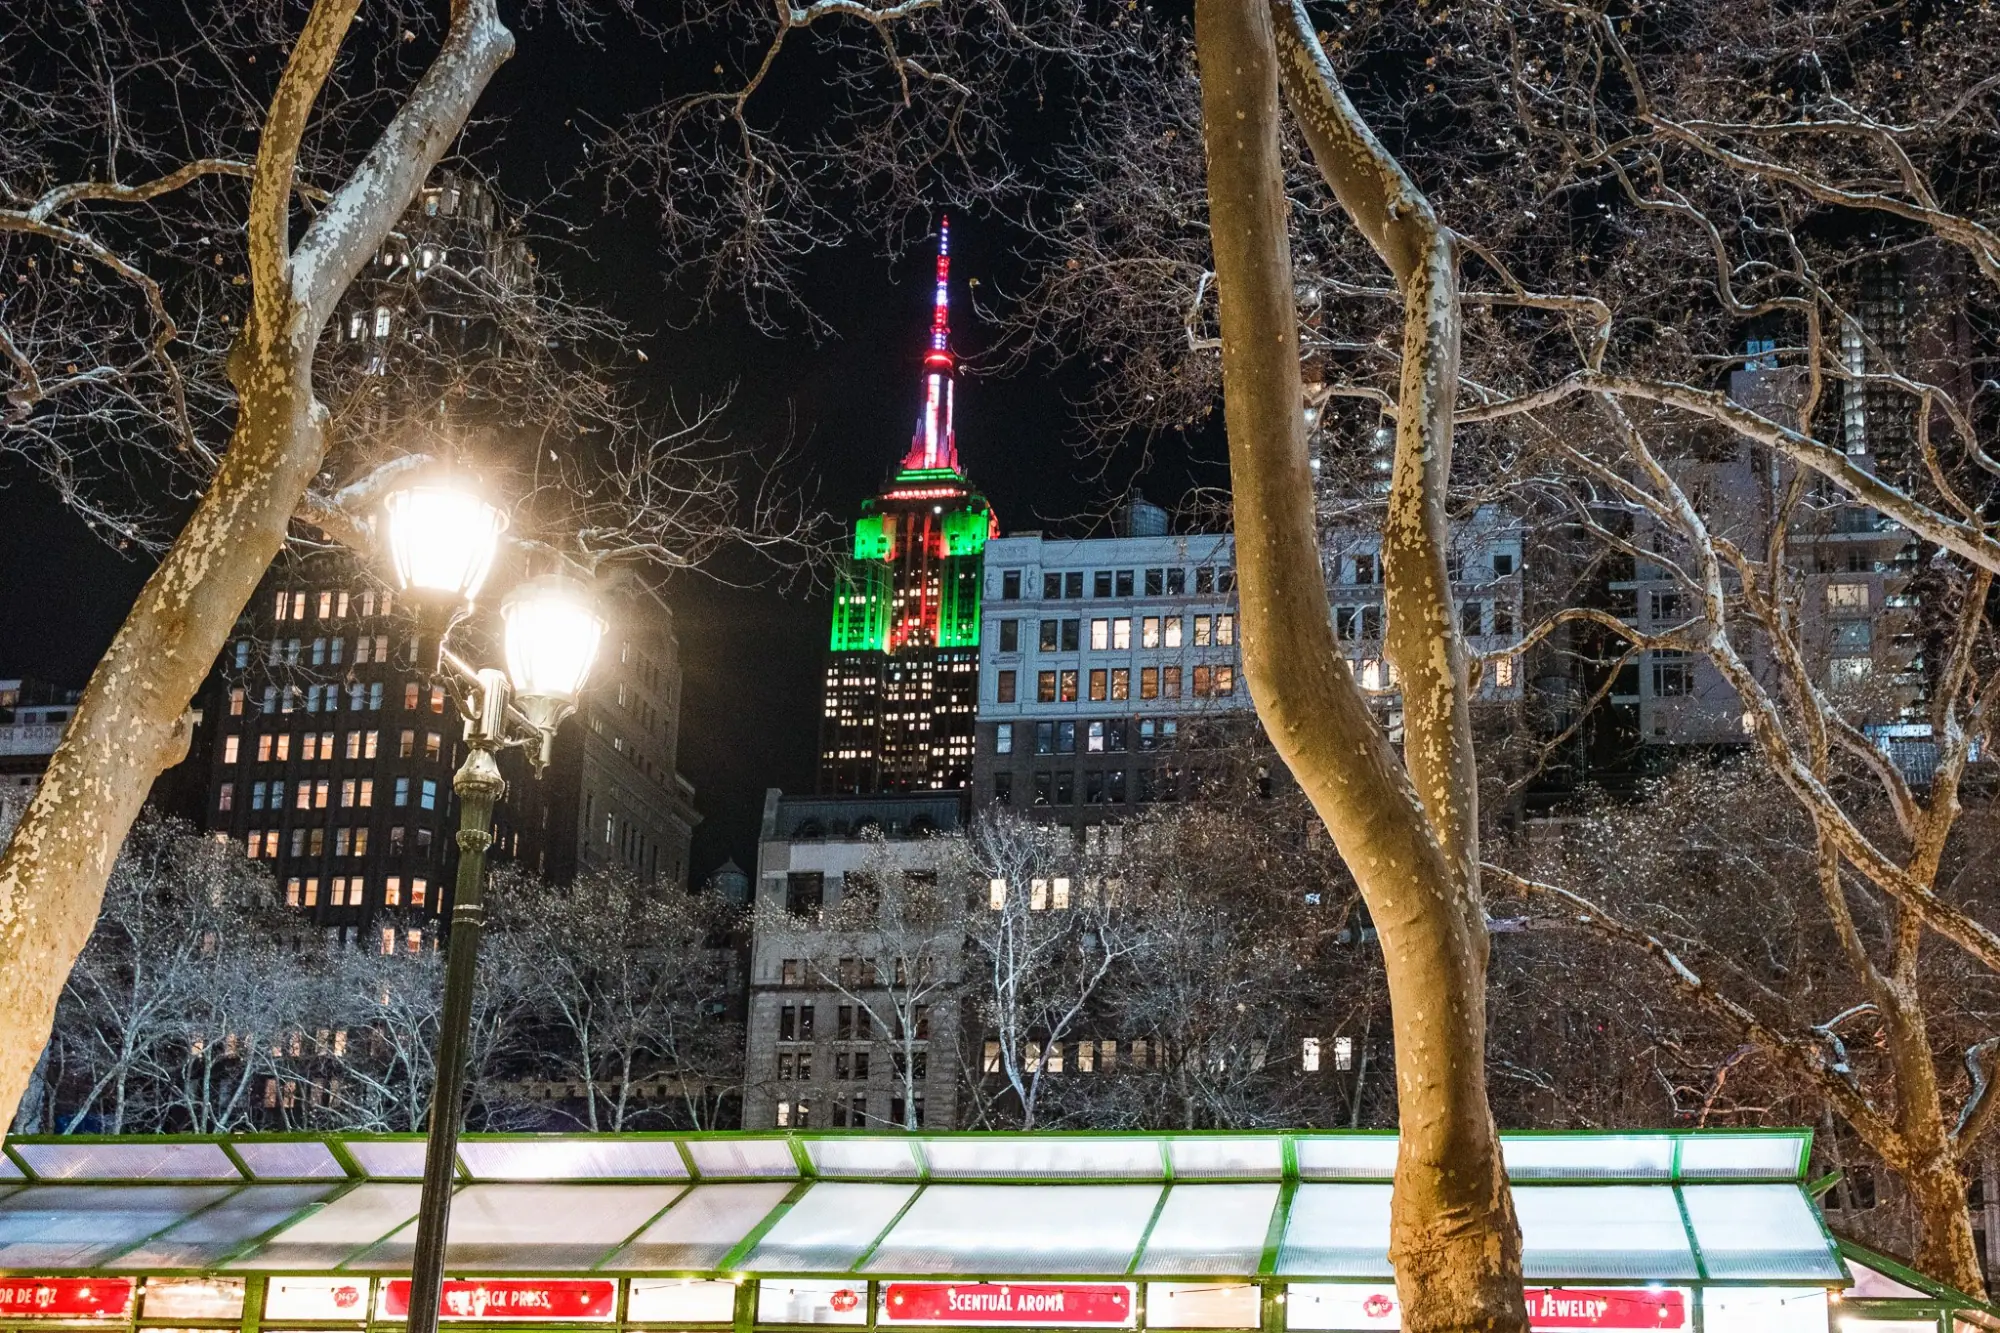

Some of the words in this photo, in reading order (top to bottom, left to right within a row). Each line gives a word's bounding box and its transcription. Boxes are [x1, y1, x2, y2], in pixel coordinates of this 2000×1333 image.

[16, 1288, 32, 1304] DE
[949, 1294, 1012, 1311] SCENTUAL
[1017, 1294, 1064, 1312] AROMA
[1541, 1298, 1604, 1317] JEWELRY
